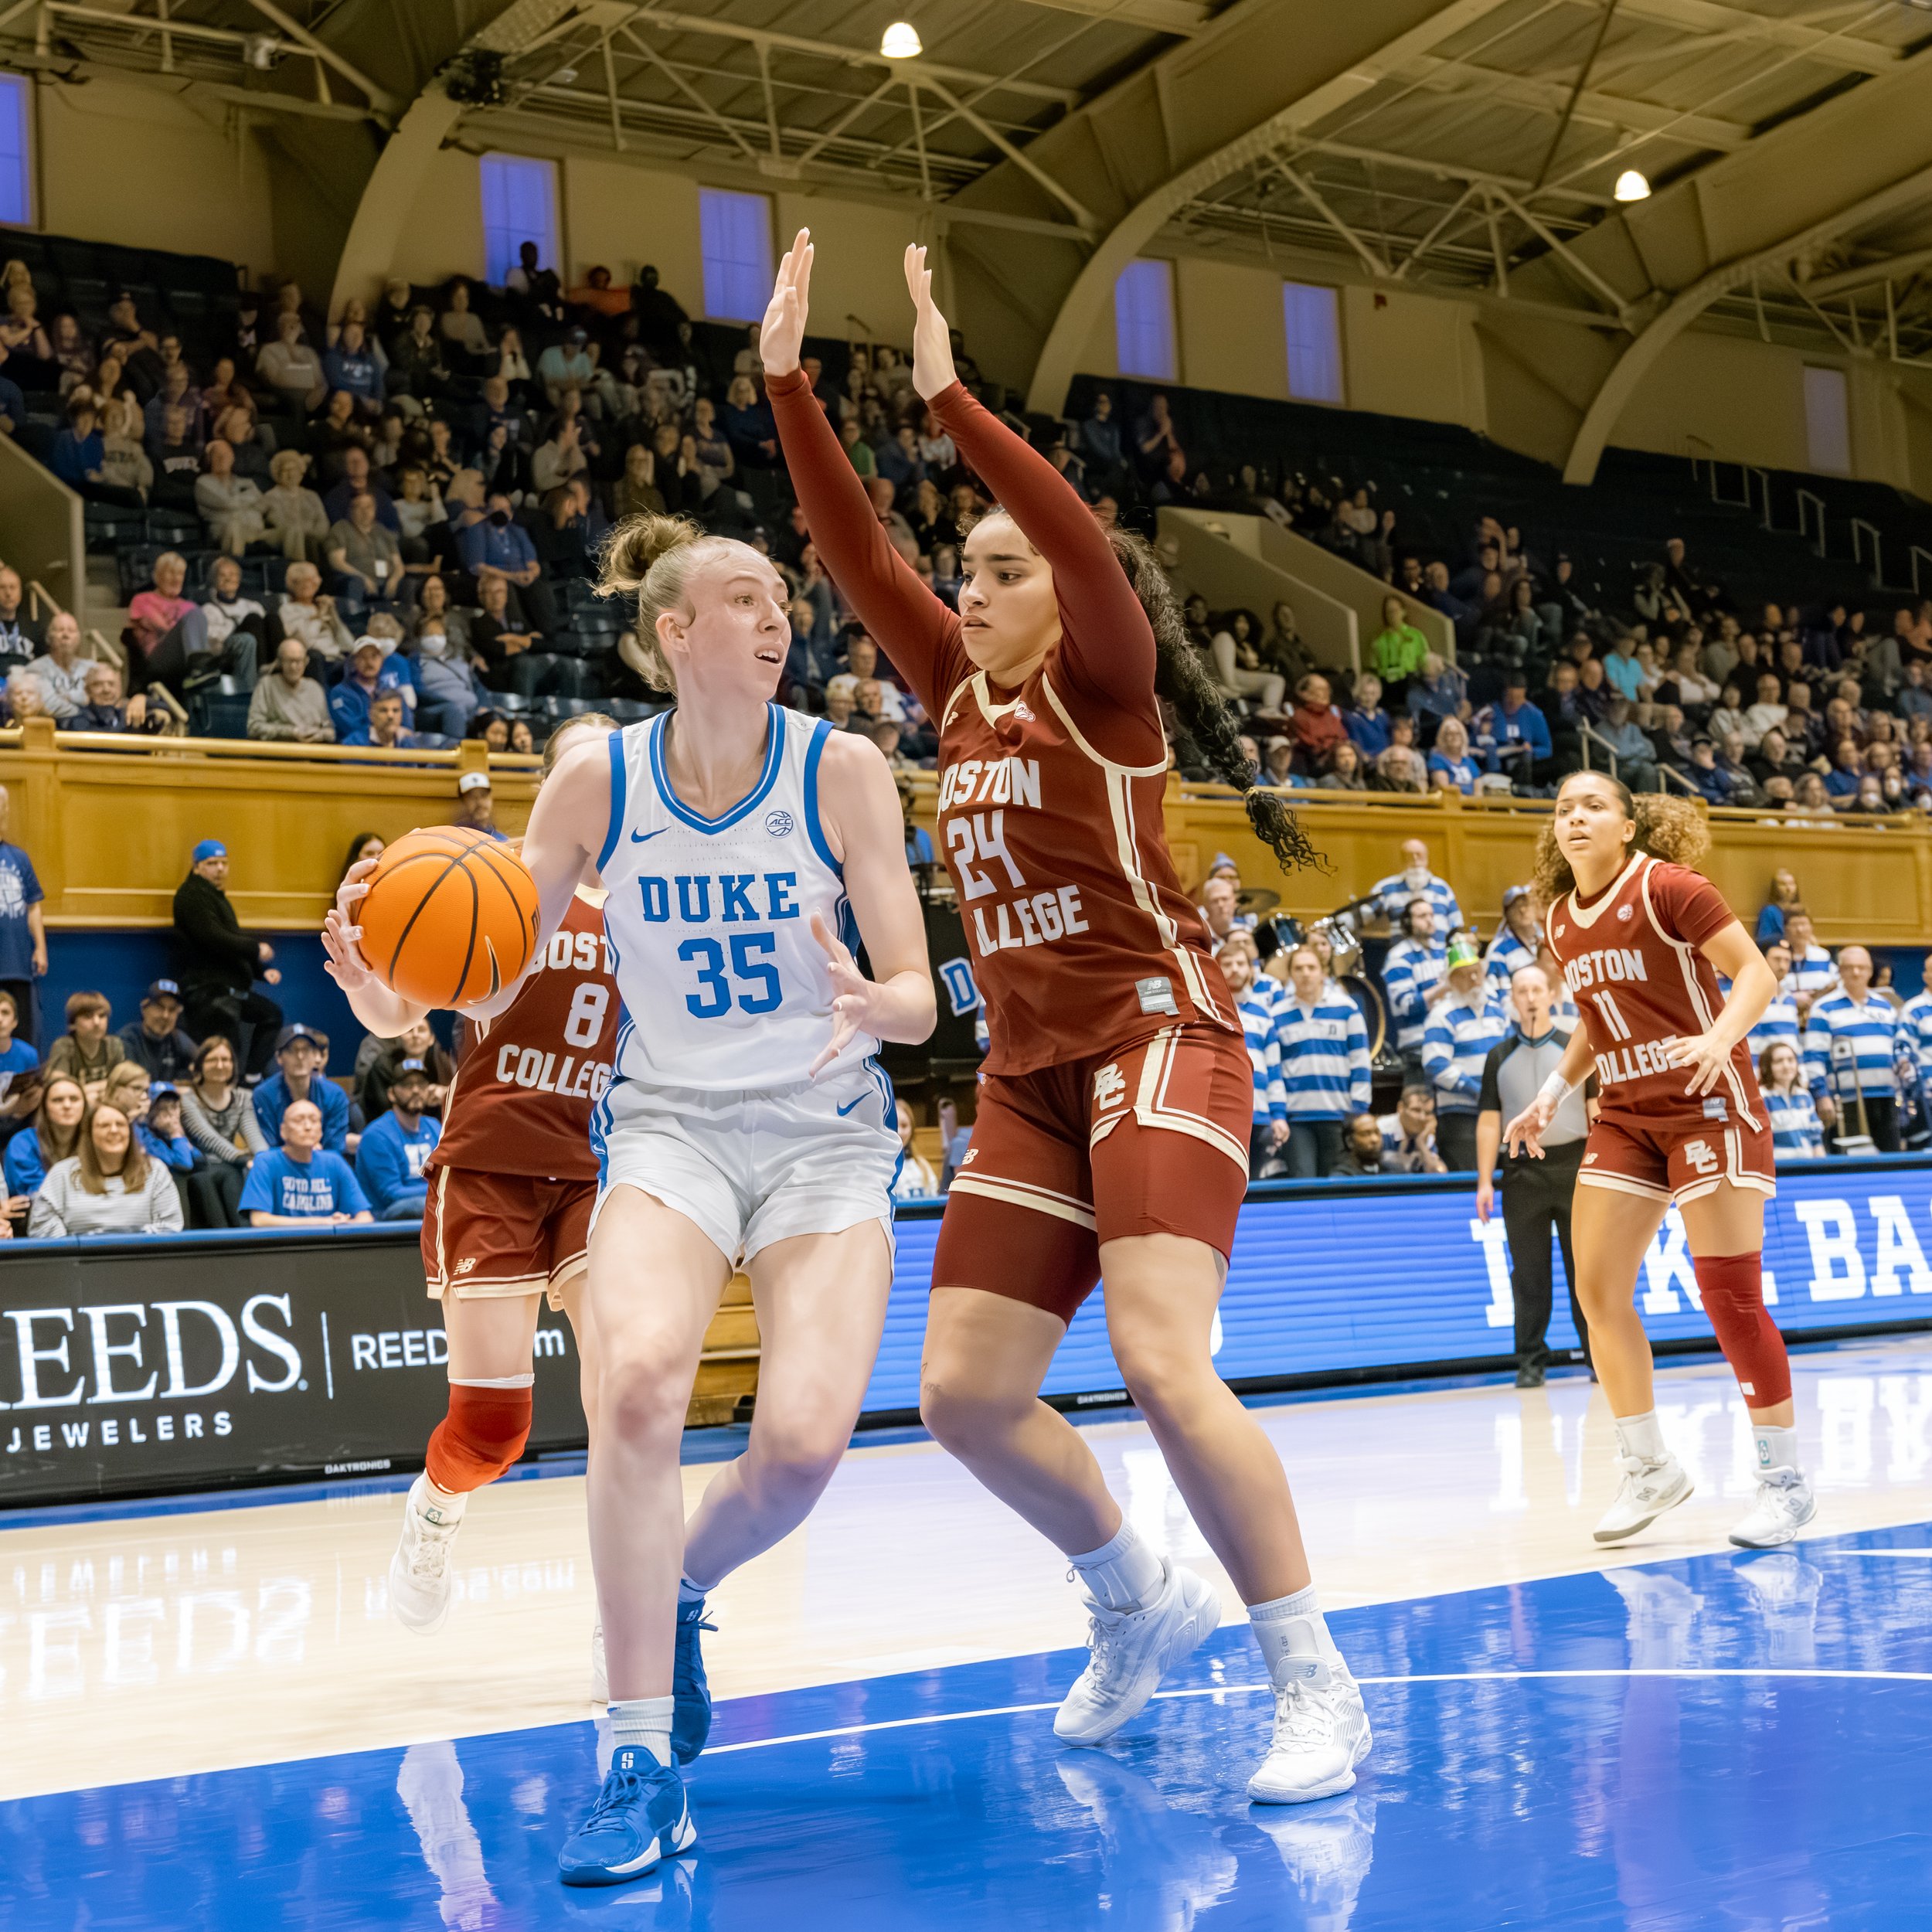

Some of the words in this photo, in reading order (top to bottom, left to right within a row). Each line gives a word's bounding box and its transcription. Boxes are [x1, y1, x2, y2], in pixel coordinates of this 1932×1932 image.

[937, 757, 1042, 821] OSTON
[947, 809, 1026, 901] 24
[638, 872, 800, 923] DUKE
[971, 885, 1090, 957] LLEGE
[526, 930, 613, 975] OST
[676, 931, 783, 1019] 35
[1564, 948, 1648, 993] OSTON
[940, 959, 978, 1014] D
[563, 982, 610, 1049] 8
[1592, 990, 1631, 1041] 11
[497, 1044, 612, 1101] COLLEG
[1595, 1035, 1682, 1086] OLLEG
[1794, 1195, 1932, 1301] BA
[0, 1293, 308, 1410] EEDS
[6, 1411, 233, 1453] JEWELERS
